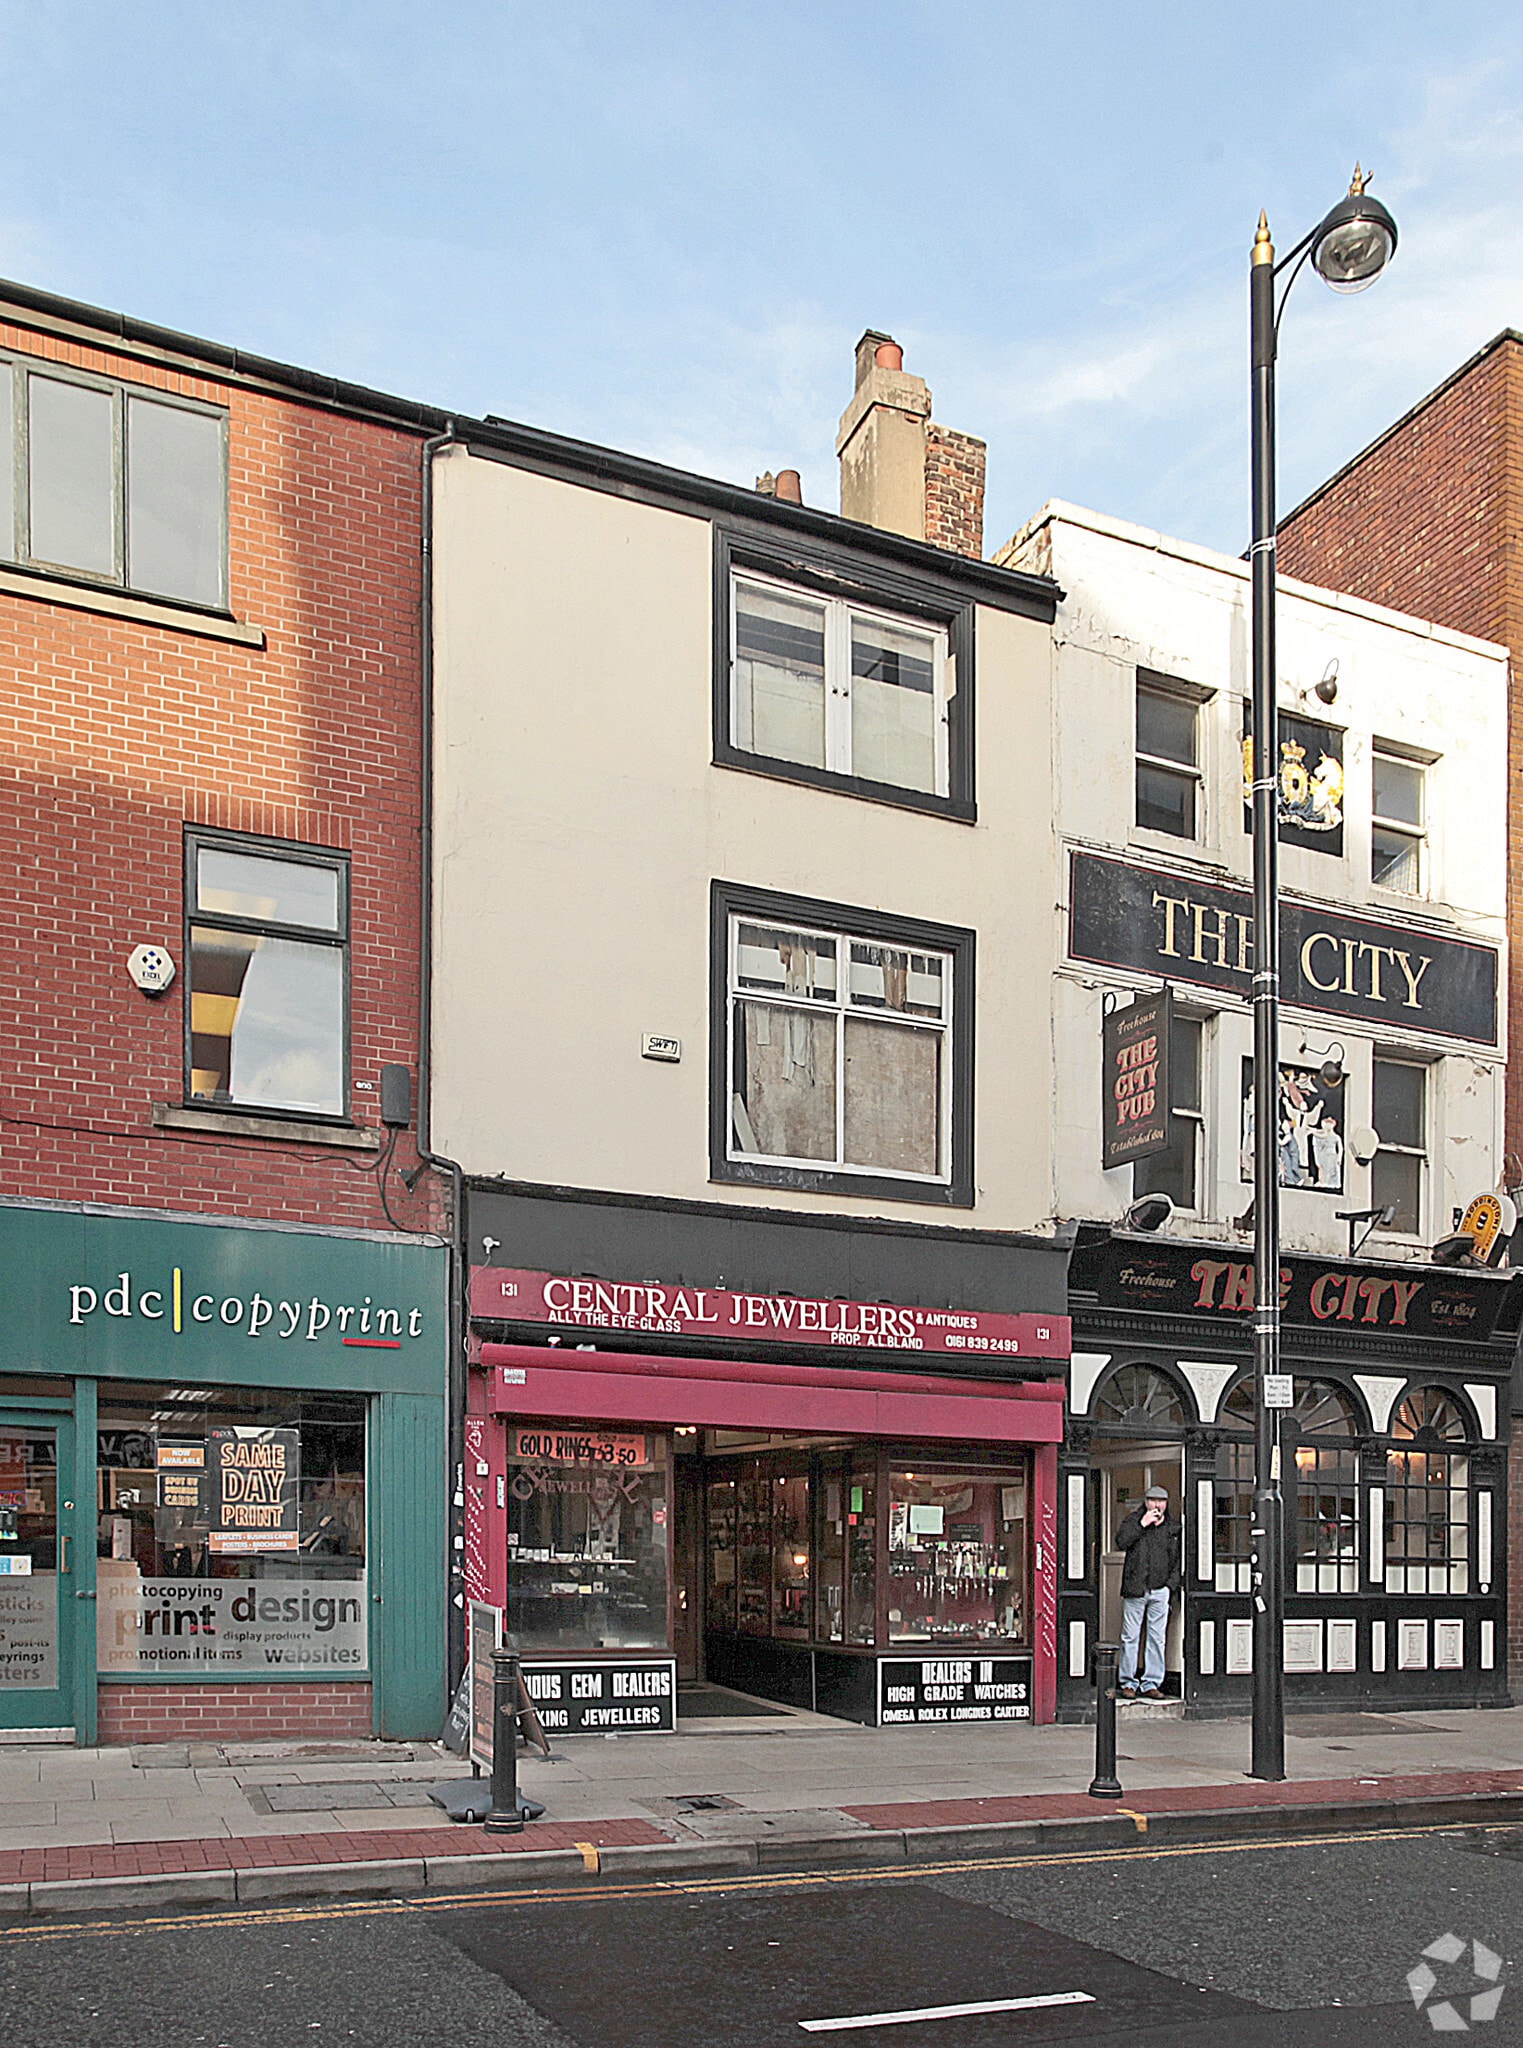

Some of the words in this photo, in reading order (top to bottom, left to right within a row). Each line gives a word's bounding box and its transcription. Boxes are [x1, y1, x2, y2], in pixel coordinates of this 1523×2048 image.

[1152, 890, 1254, 973] THE
[1301, 932, 1432, 1009] CITY
[1117, 1010, 1157, 1035] Freehouse
[1116, 1036, 1158, 1073] THE
[1114, 1060, 1160, 1100] CITY
[1116, 1090, 1156, 1125] PUB
[501, 1282, 518, 1297] 131
[1119, 1268, 1177, 1289] Freehouse
[69, 1272, 164, 1323] pdc
[192, 1293, 422, 1340] copyprint
[543, 1279, 719, 1322] CENTRAL
[729, 1294, 916, 1338] JEWELLERS
[915, 1312, 924, 1325] &
[926, 1313, 978, 1330] ANTIQUES
[1310, 1272, 1425, 1326] CITY
[548, 1310, 581, 1324] ALLY
[586, 1312, 609, 1326] THE
[611, 1315, 682, 1333] EYE-GLASS
[831, 1331, 861, 1346] PROP.
[945, 1335, 966, 1348] 0161
[967, 1337, 988, 1350] 839
[990, 1339, 1019, 1353] 2499
[1037, 1328, 1050, 1340] 131
[220, 1443, 286, 1469] SAME
[520, 1434, 552, 1456] GOLD
[557, 1436, 592, 1459] RINGS
[161, 1457, 201, 1465] AVAILABLE
[222, 1468, 286, 1503] DAY
[221, 1504, 284, 1528] PRINT
[109, 1583, 223, 1600] photocopying
[231, 1587, 362, 1632] design
[115, 1600, 216, 1646] print
[223, 1631, 261, 1642] display
[264, 1632, 311, 1642] products
[109, 1648, 200, 1662] promotional
[203, 1647, 242, 1660] items
[265, 1645, 361, 1663] websites
[921, 1661, 972, 1685] DEALERS
[979, 1660, 993, 1683] IN
[524, 1675, 561, 1699] IOUS
[571, 1673, 602, 1698] GEM
[612, 1672, 670, 1697] DEALERS
[887, 1686, 915, 1703] HIGH
[924, 1685, 964, 1701] GRADE
[974, 1683, 1026, 1700] WATCHES
[533, 1709, 569, 1727] KING
[580, 1707, 661, 1726] JEWELLERS
[883, 1708, 915, 1722] OMEGA
[918, 1707, 948, 1721] ROLEX
[951, 1706, 992, 1720] LONGINES
[994, 1705, 1030, 1718] CARTIER
